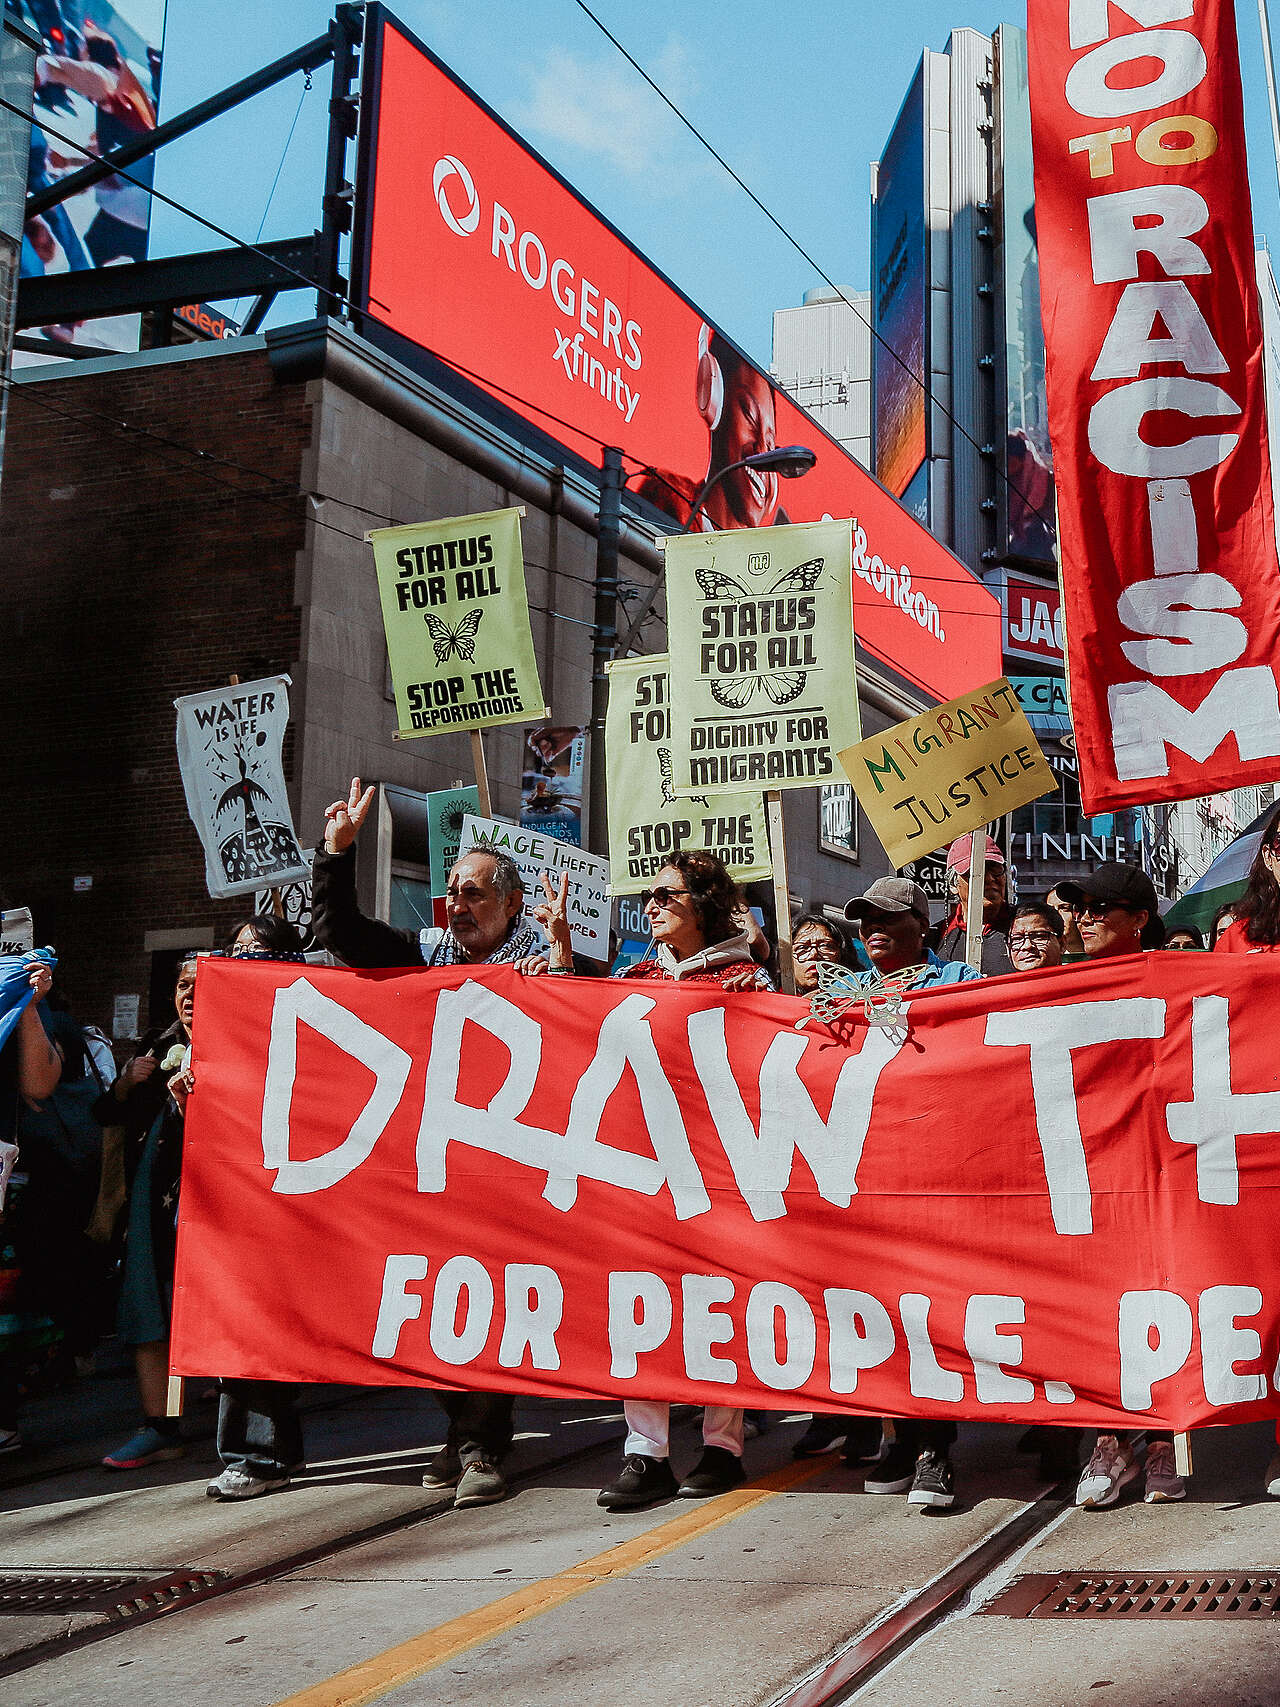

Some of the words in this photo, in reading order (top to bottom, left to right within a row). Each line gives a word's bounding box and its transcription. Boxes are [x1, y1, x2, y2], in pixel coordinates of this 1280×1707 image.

[1068, 114, 1218, 178] TO
[491, 201, 642, 371] ROGERS
[551, 327, 640, 423] xfinity
[397, 534, 493, 578] STATUS
[396, 577, 447, 611] FOR
[457, 566, 501, 600] ALL
[701, 596, 816, 639] STATUS
[700, 641, 756, 674] FOR
[768, 634, 817, 666] ALL
[194, 692, 275, 730] WATER
[408, 676, 464, 711] STOP
[471, 668, 518, 700] THE
[216, 727, 229, 743] IS
[234, 719, 257, 739] LIFE
[411, 696, 524, 730] DEPORTATIONS
[691, 721, 778, 752] DIGNITY
[786, 717, 829, 742] FOR
[863, 685, 1017, 793] MIGRANT
[690, 746, 833, 786] MIGRANTS
[893, 746, 1036, 839] JUSTICE
[471, 824, 545, 860] WAGE
[628, 820, 691, 857] STOP
[701, 814, 753, 846] THE
[571, 899, 600, 918] AND
[619, 899, 650, 934] fido
[260, 977, 911, 1222] DRAW
[372, 1254, 564, 1370] FOR
[608, 1271, 1075, 1405] PEOPLE.
